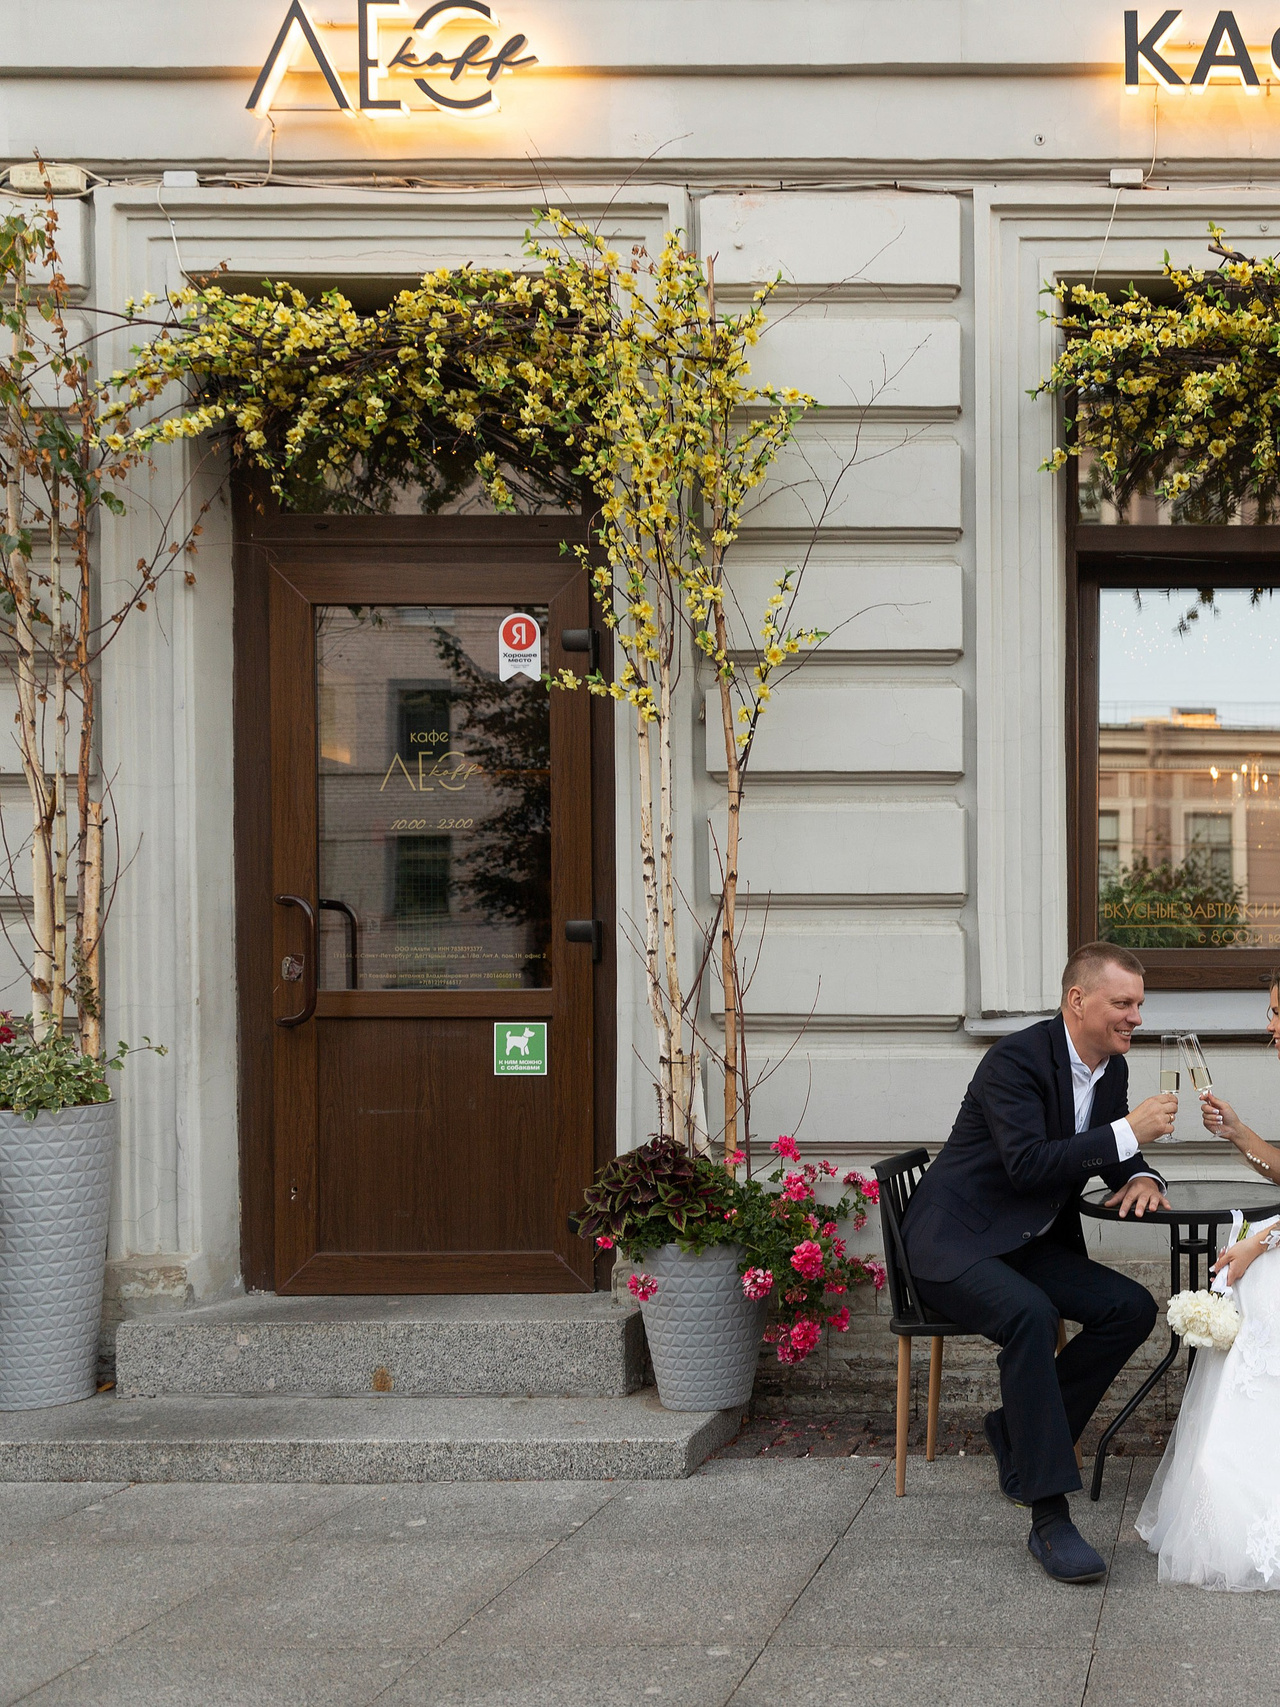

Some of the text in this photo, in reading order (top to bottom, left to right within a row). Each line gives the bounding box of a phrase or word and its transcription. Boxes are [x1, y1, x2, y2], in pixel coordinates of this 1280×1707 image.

[387, 33, 539, 82] koff
[511, 622, 527, 645] Я
[410, 729, 449, 746] кафе
[429, 763, 482, 781] koff
[391, 819, 427, 830] 10.00
[436, 818, 474, 830] 23.00
[1103, 902, 1179, 919] ВКУСНЫЕ
[1184, 902, 1268, 919] ЗАВТРАКИ
[1210, 929, 1250, 944] 8.00
[1254, 934, 1263, 943] и
